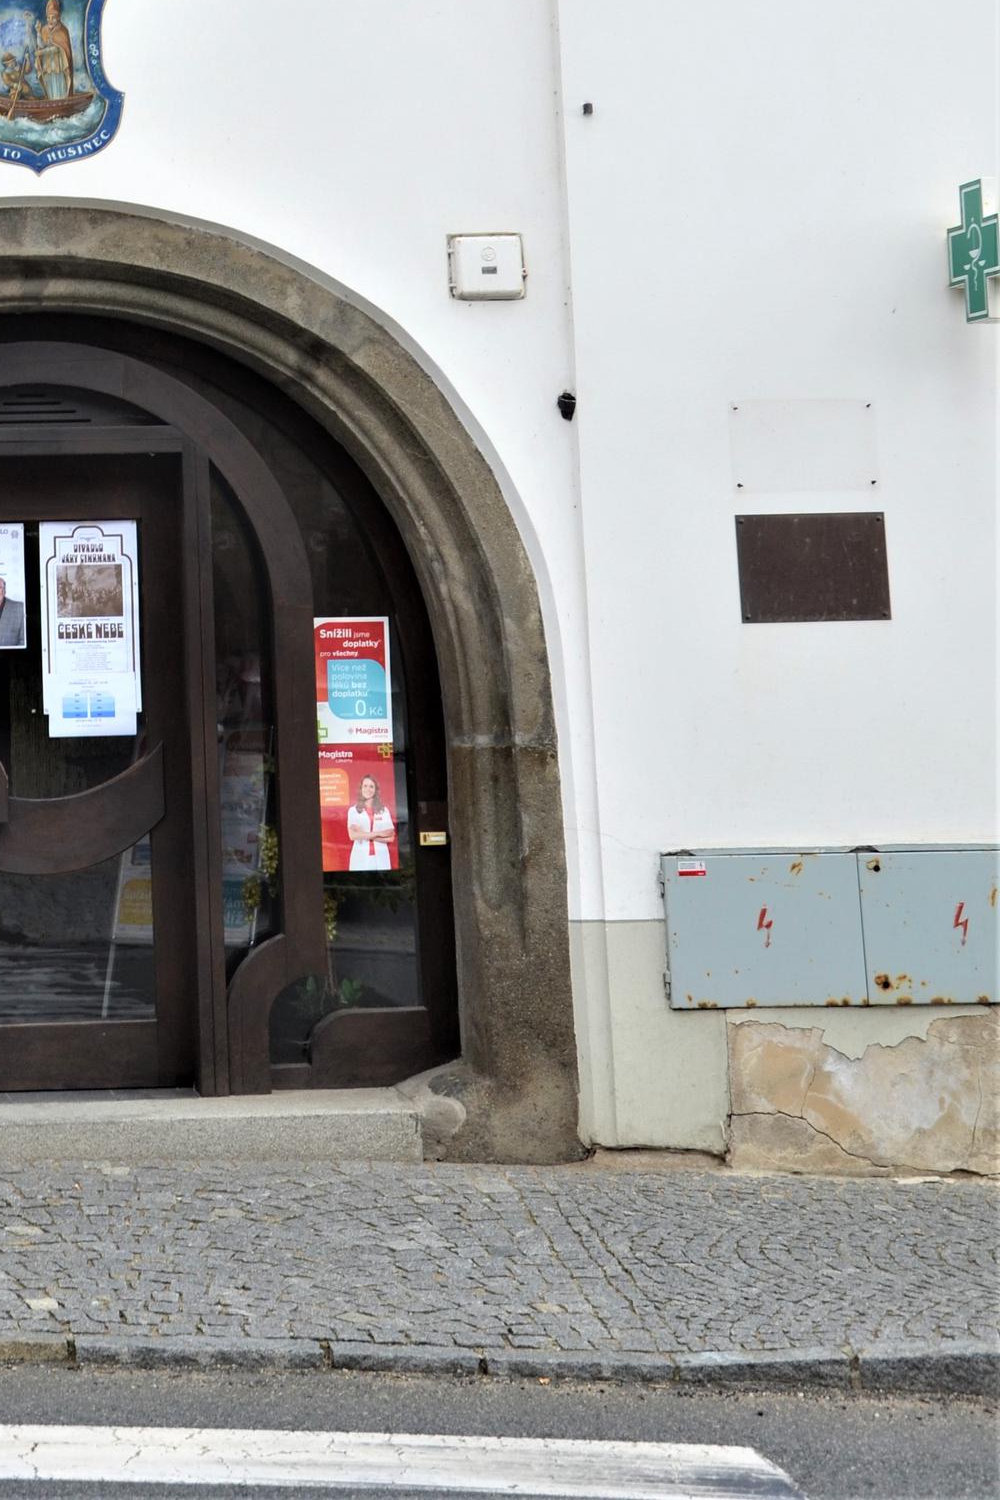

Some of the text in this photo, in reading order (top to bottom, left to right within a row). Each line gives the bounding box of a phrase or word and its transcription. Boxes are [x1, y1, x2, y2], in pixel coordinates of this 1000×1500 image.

[46, 128, 111, 163] HUSINEC
[73, 543, 104, 553] DIVADLO
[58, 622, 124, 639] ČESKÉ NEBE
[319, 628, 370, 639] Snížili jsme
[331, 664, 349, 672] Více
[332, 673, 368, 681] polovina
[355, 700, 383, 716] 0 Kč
[355, 727, 388, 735] Magistra
[318, 750, 353, 759] Magistra
